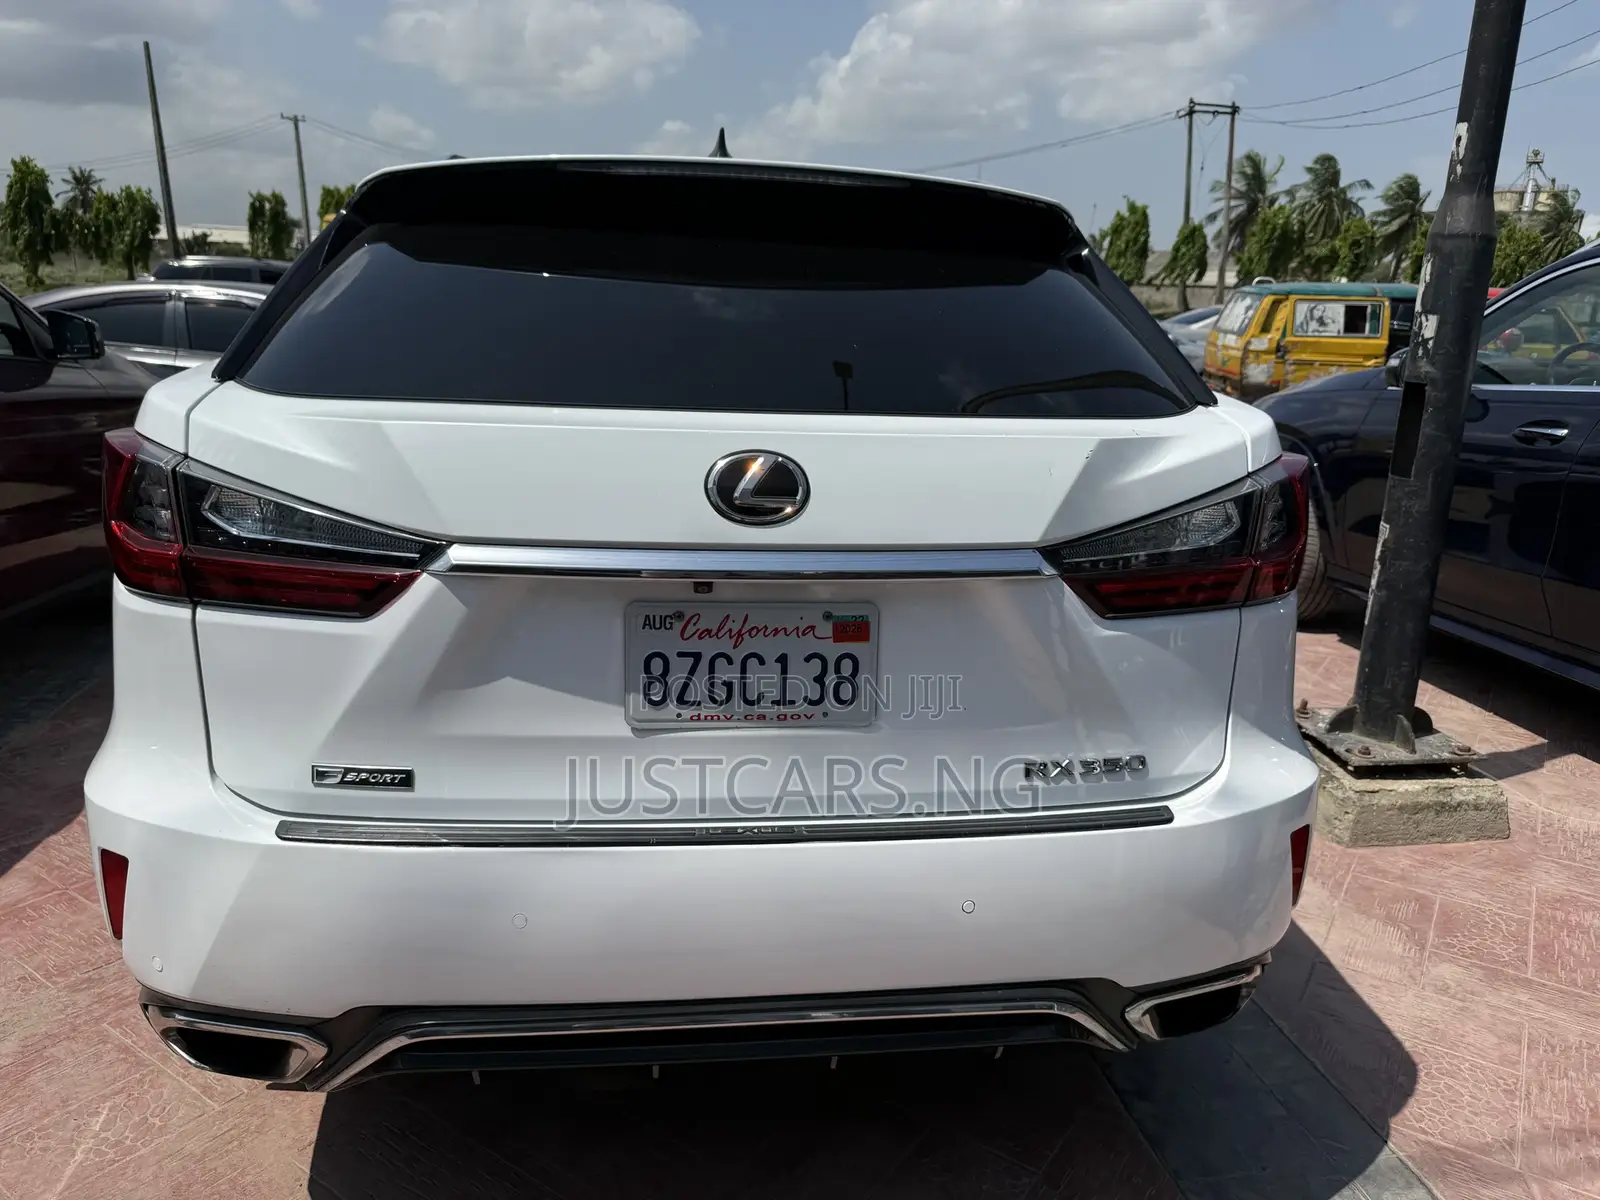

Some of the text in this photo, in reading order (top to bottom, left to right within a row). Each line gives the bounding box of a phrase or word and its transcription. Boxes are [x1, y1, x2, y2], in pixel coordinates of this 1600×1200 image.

[642, 614, 675, 631] AUG
[679, 612, 832, 649] California
[643, 651, 860, 707] 8ZGC138
[689, 712, 817, 722] dmv.ca.gov
[343, 772, 406, 783] SPORT
